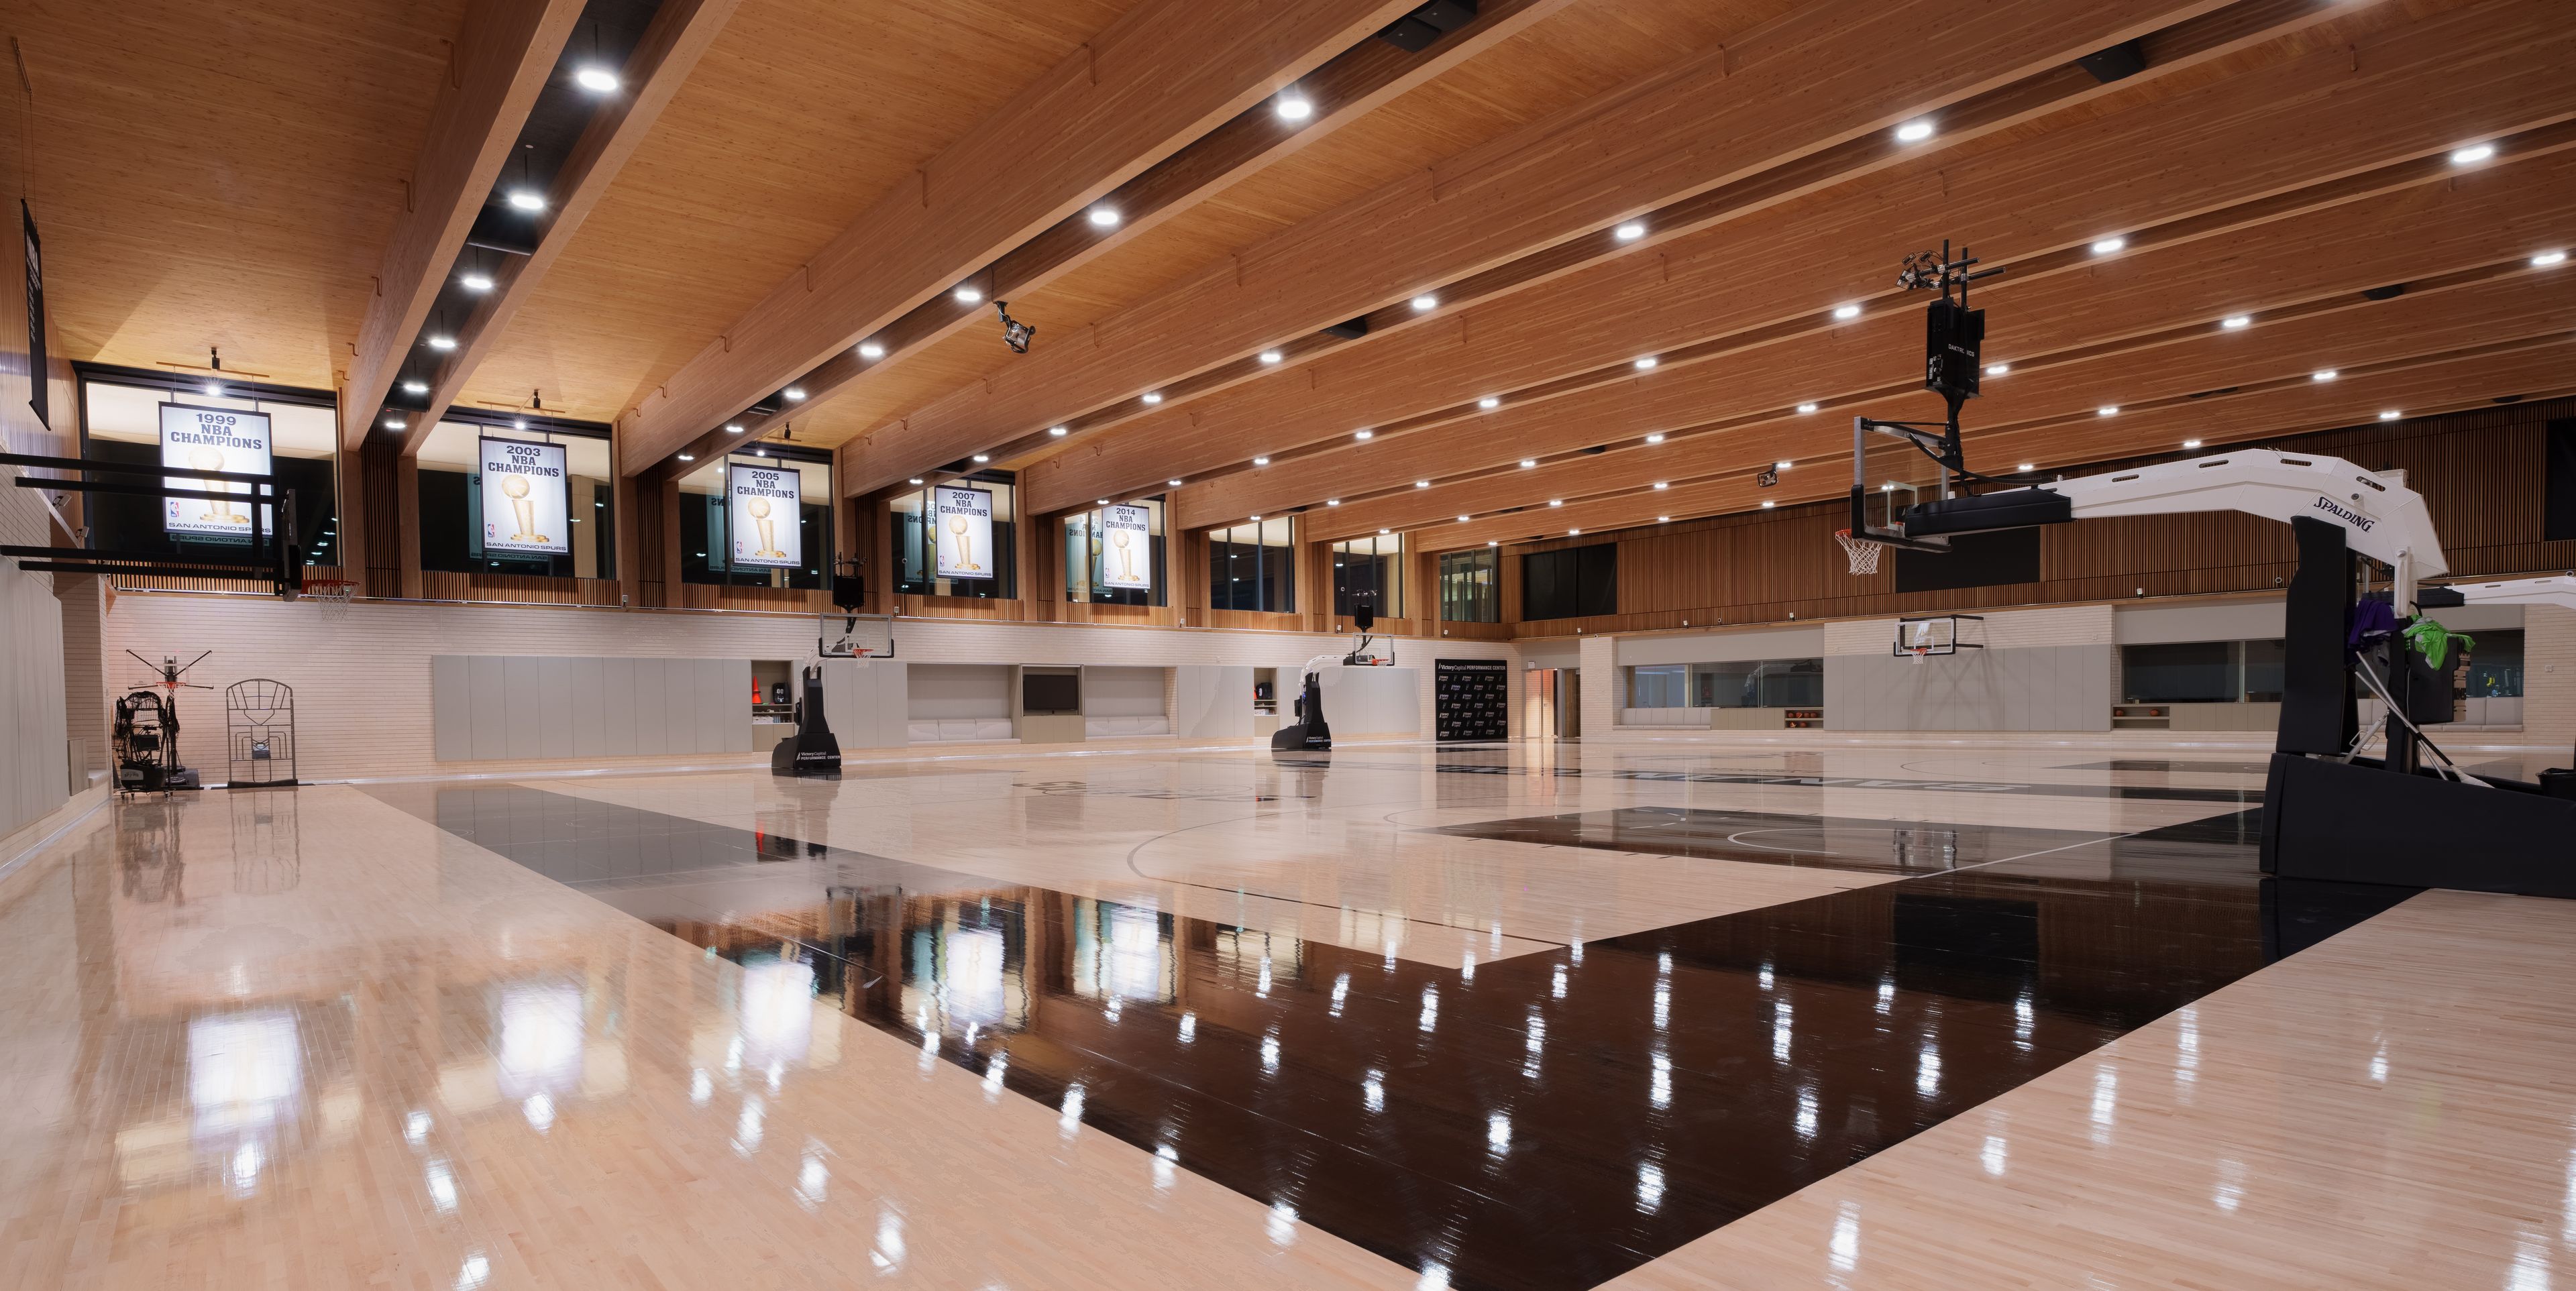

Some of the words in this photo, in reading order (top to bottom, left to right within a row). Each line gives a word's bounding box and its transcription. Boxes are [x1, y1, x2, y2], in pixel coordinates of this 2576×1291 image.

[196, 413, 237, 426] 1999
[201, 423, 233, 437] NBA
[170, 431, 262, 450] CHAMPIONS
[506, 445, 541, 457] 2003
[511, 455, 536, 466] NBA
[488, 461, 559, 478] CHAMPIONS
[751, 471, 780, 481] 2005
[755, 479, 776, 489] NBA
[737, 486, 794, 499] CHAMPIONS
[952, 492, 975, 500] 2007
[955, 499, 972, 508] NBA
[940, 505, 987, 517] CHAMPIONS
[1116, 508, 1135, 516] 2014
[2313, 496, 2375, 532] SPALDING
[1119, 514, 1133, 522] NBA
[1106, 520, 1146, 531] CHAMPIONS
